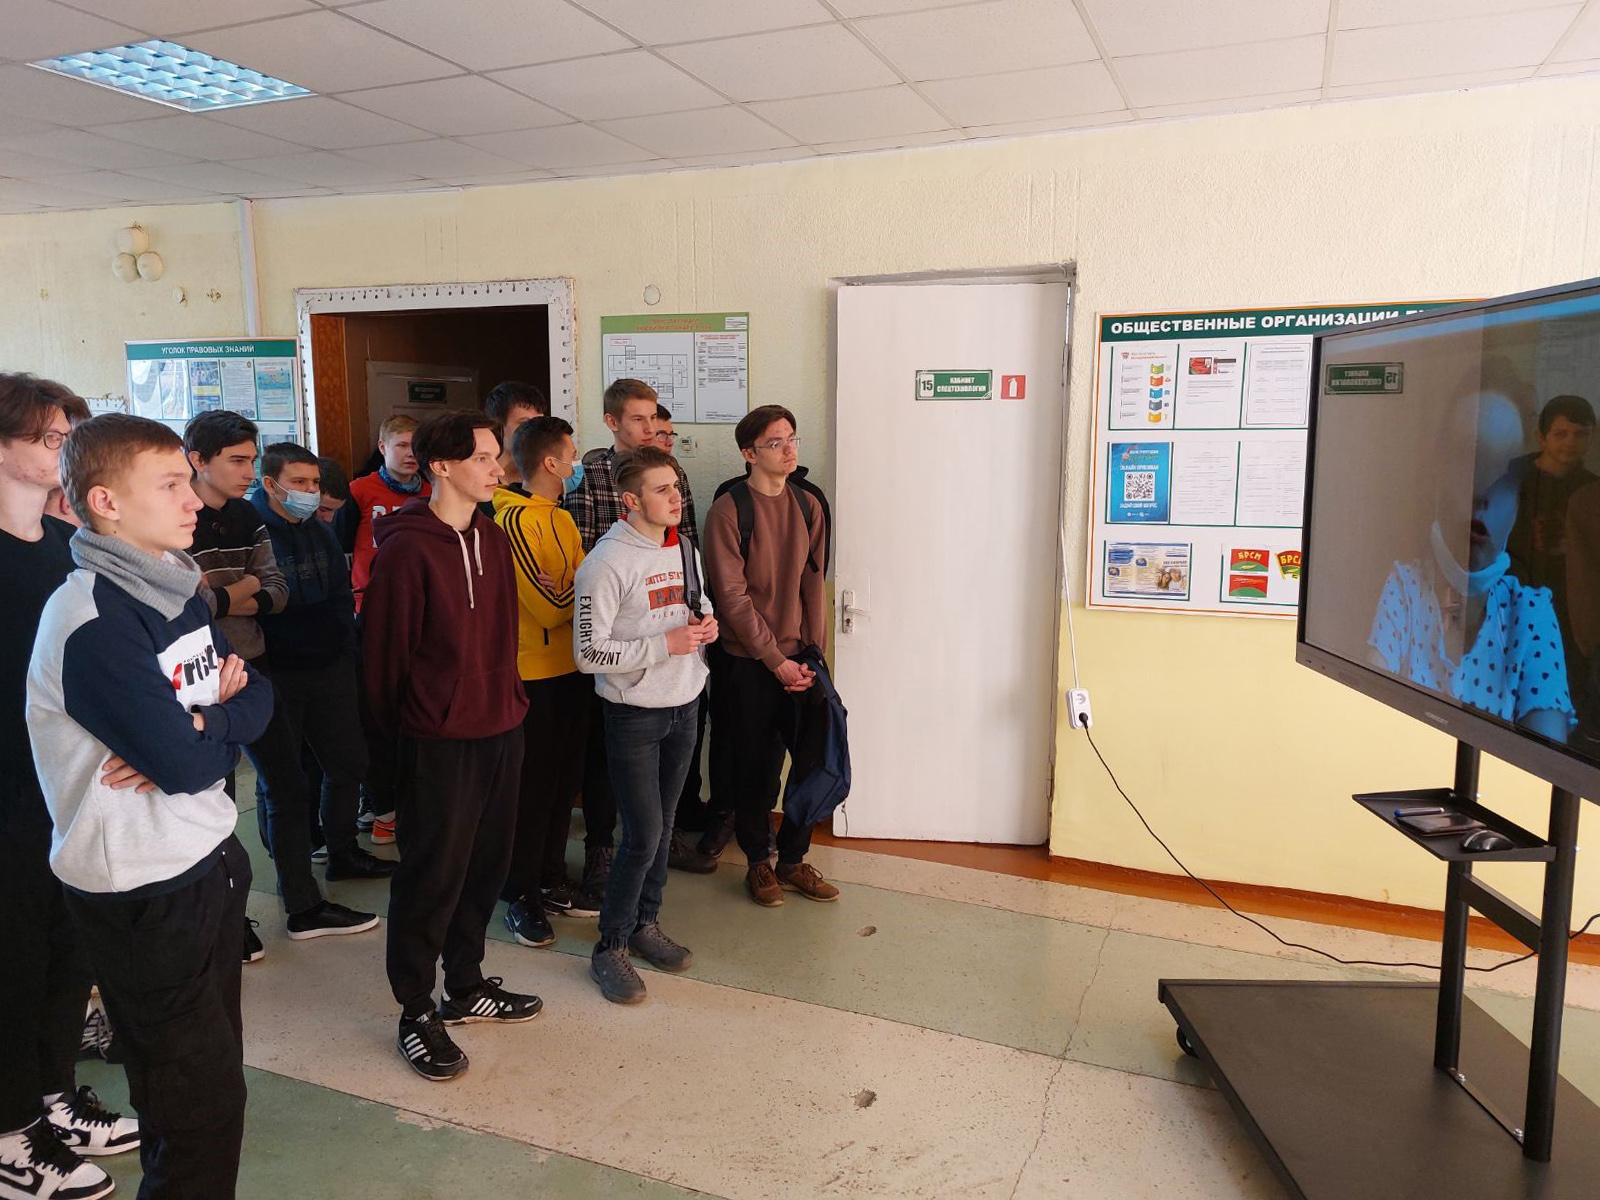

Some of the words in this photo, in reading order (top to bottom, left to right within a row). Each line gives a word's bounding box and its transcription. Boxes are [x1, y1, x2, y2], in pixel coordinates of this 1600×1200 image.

[1111, 316, 1256, 335] ОБЩЕСТВЕННЫЕ
[1261, 310, 1399, 328] ОРГАНИЗАЦИИ
[161, 346, 186, 355] УГОЛОК
[186, 346, 224, 354] ПРАВОВЫХ
[225, 345, 255, 353] ЗНАНИЙ
[921, 380, 933, 391] 15
[1238, 551, 1262, 560] БРСМ
[1280, 554, 1301, 565] БРС
[579, 596, 592, 644] EXLIGHT
